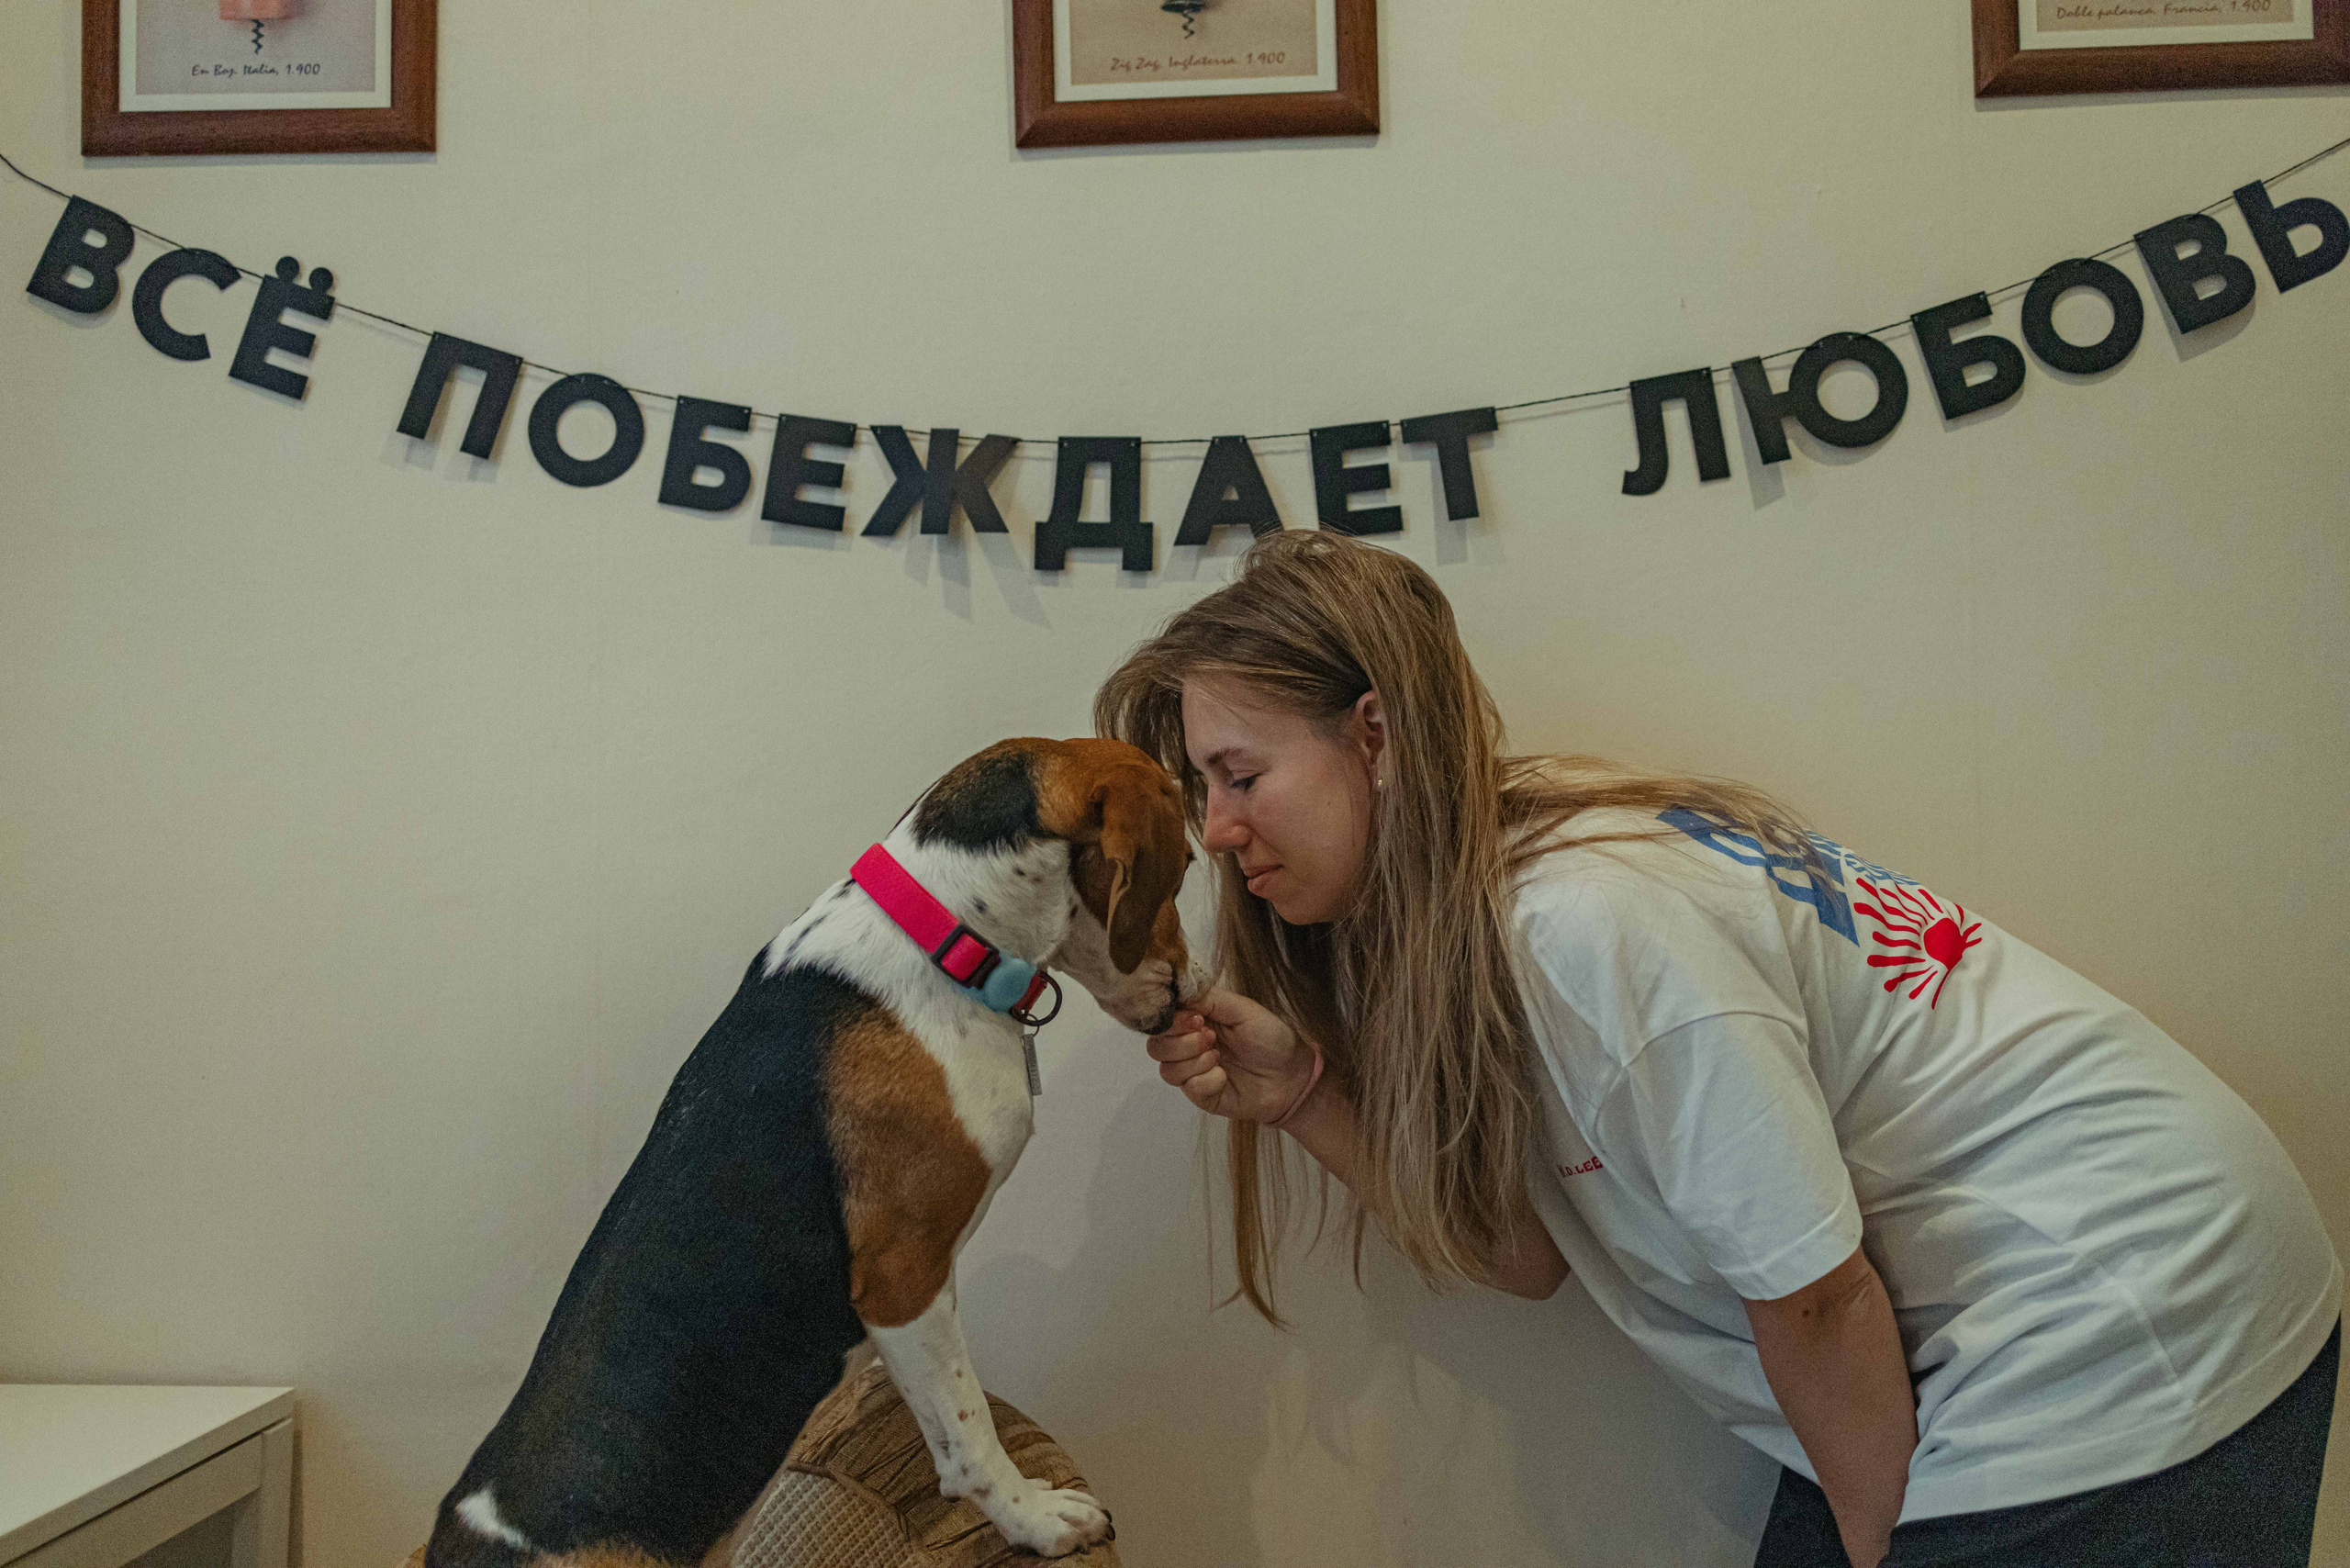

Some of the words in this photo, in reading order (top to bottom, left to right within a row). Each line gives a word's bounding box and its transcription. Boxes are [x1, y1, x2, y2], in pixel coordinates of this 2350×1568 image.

[2056, 6, 2093, 19] Doble
[285, 63, 320, 75] 1.900
[1111, 57, 1131, 73] Zig
[27, 194, 335, 400] ВСЁ
[396, 330, 1499, 571] ПОБЕЖДАЕТ
[1621, 180, 2350, 497] ЛЮБОВЬ
